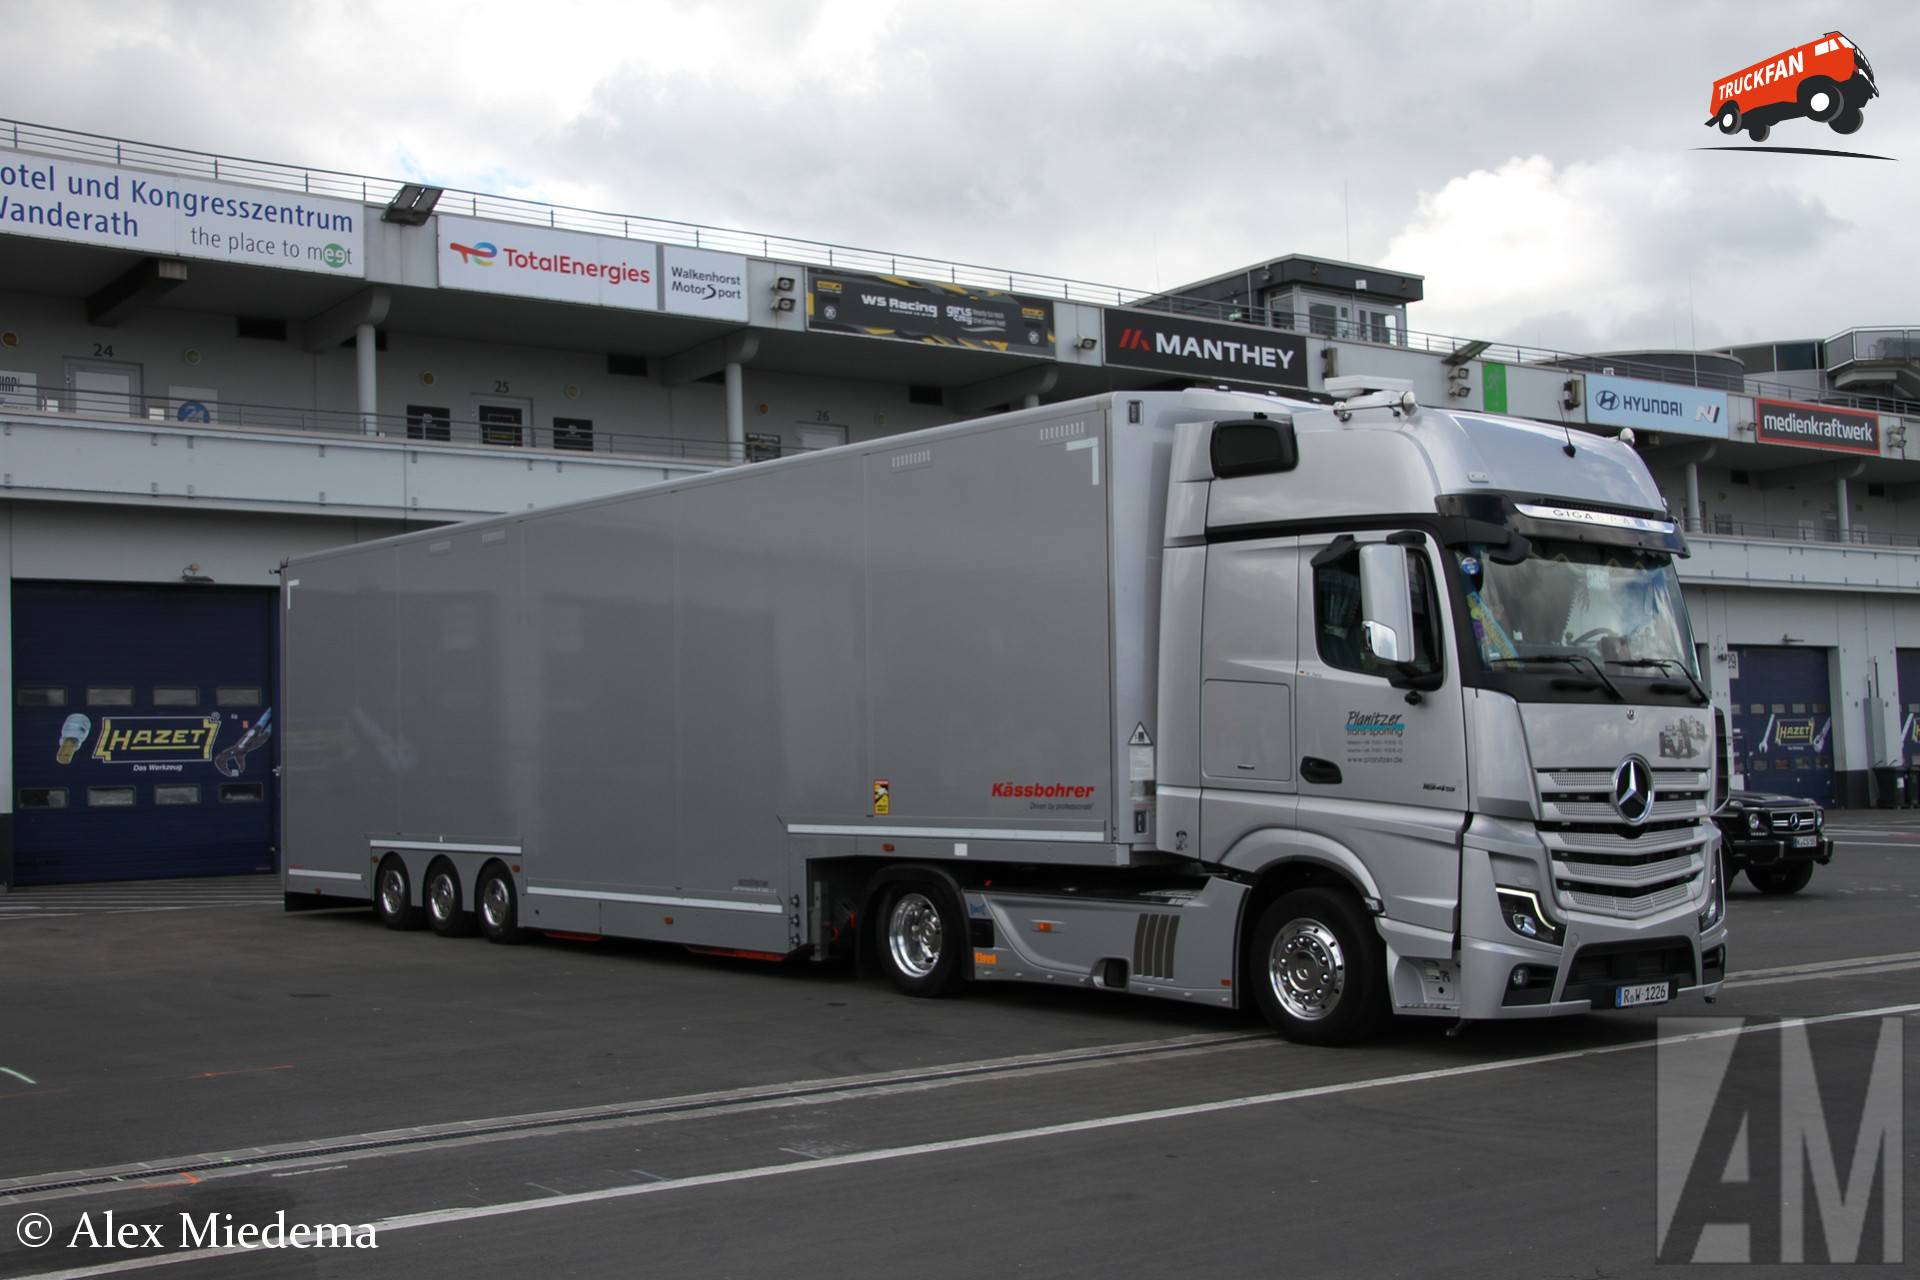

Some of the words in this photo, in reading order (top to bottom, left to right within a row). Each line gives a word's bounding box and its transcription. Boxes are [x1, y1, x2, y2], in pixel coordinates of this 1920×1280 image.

[0, 165, 55, 191] otel
[67, 175, 120, 201] und
[132, 179, 353, 233] Kongresszentrum
[191, 226, 221, 248] the
[228, 232, 276, 257] place
[283, 241, 300, 258] to
[308, 244, 352, 267] meet
[503, 248, 650, 285] TotalEnergies
[671, 266, 741, 286] Walkenhorst
[861, 294, 887, 307] WS
[889, 298, 938, 318] Racing
[93, 343, 113, 357] 24
[1155, 332, 1294, 370] MANTHEY
[495, 380, 510, 393] 25
[815, 410, 830, 422] 26
[1623, 395, 1683, 417] HYUNDAI
[1763, 414, 1873, 443] medienkraftwerk
[1347, 711, 1402, 726] Planitzer
[109, 729, 205, 750] HAZET
[1780, 726, 1810, 738] HAZET
[133, 764, 147, 772] Das
[149, 763, 183, 773] Werkzeug
[992, 782, 1094, 798] Kässbohrer
